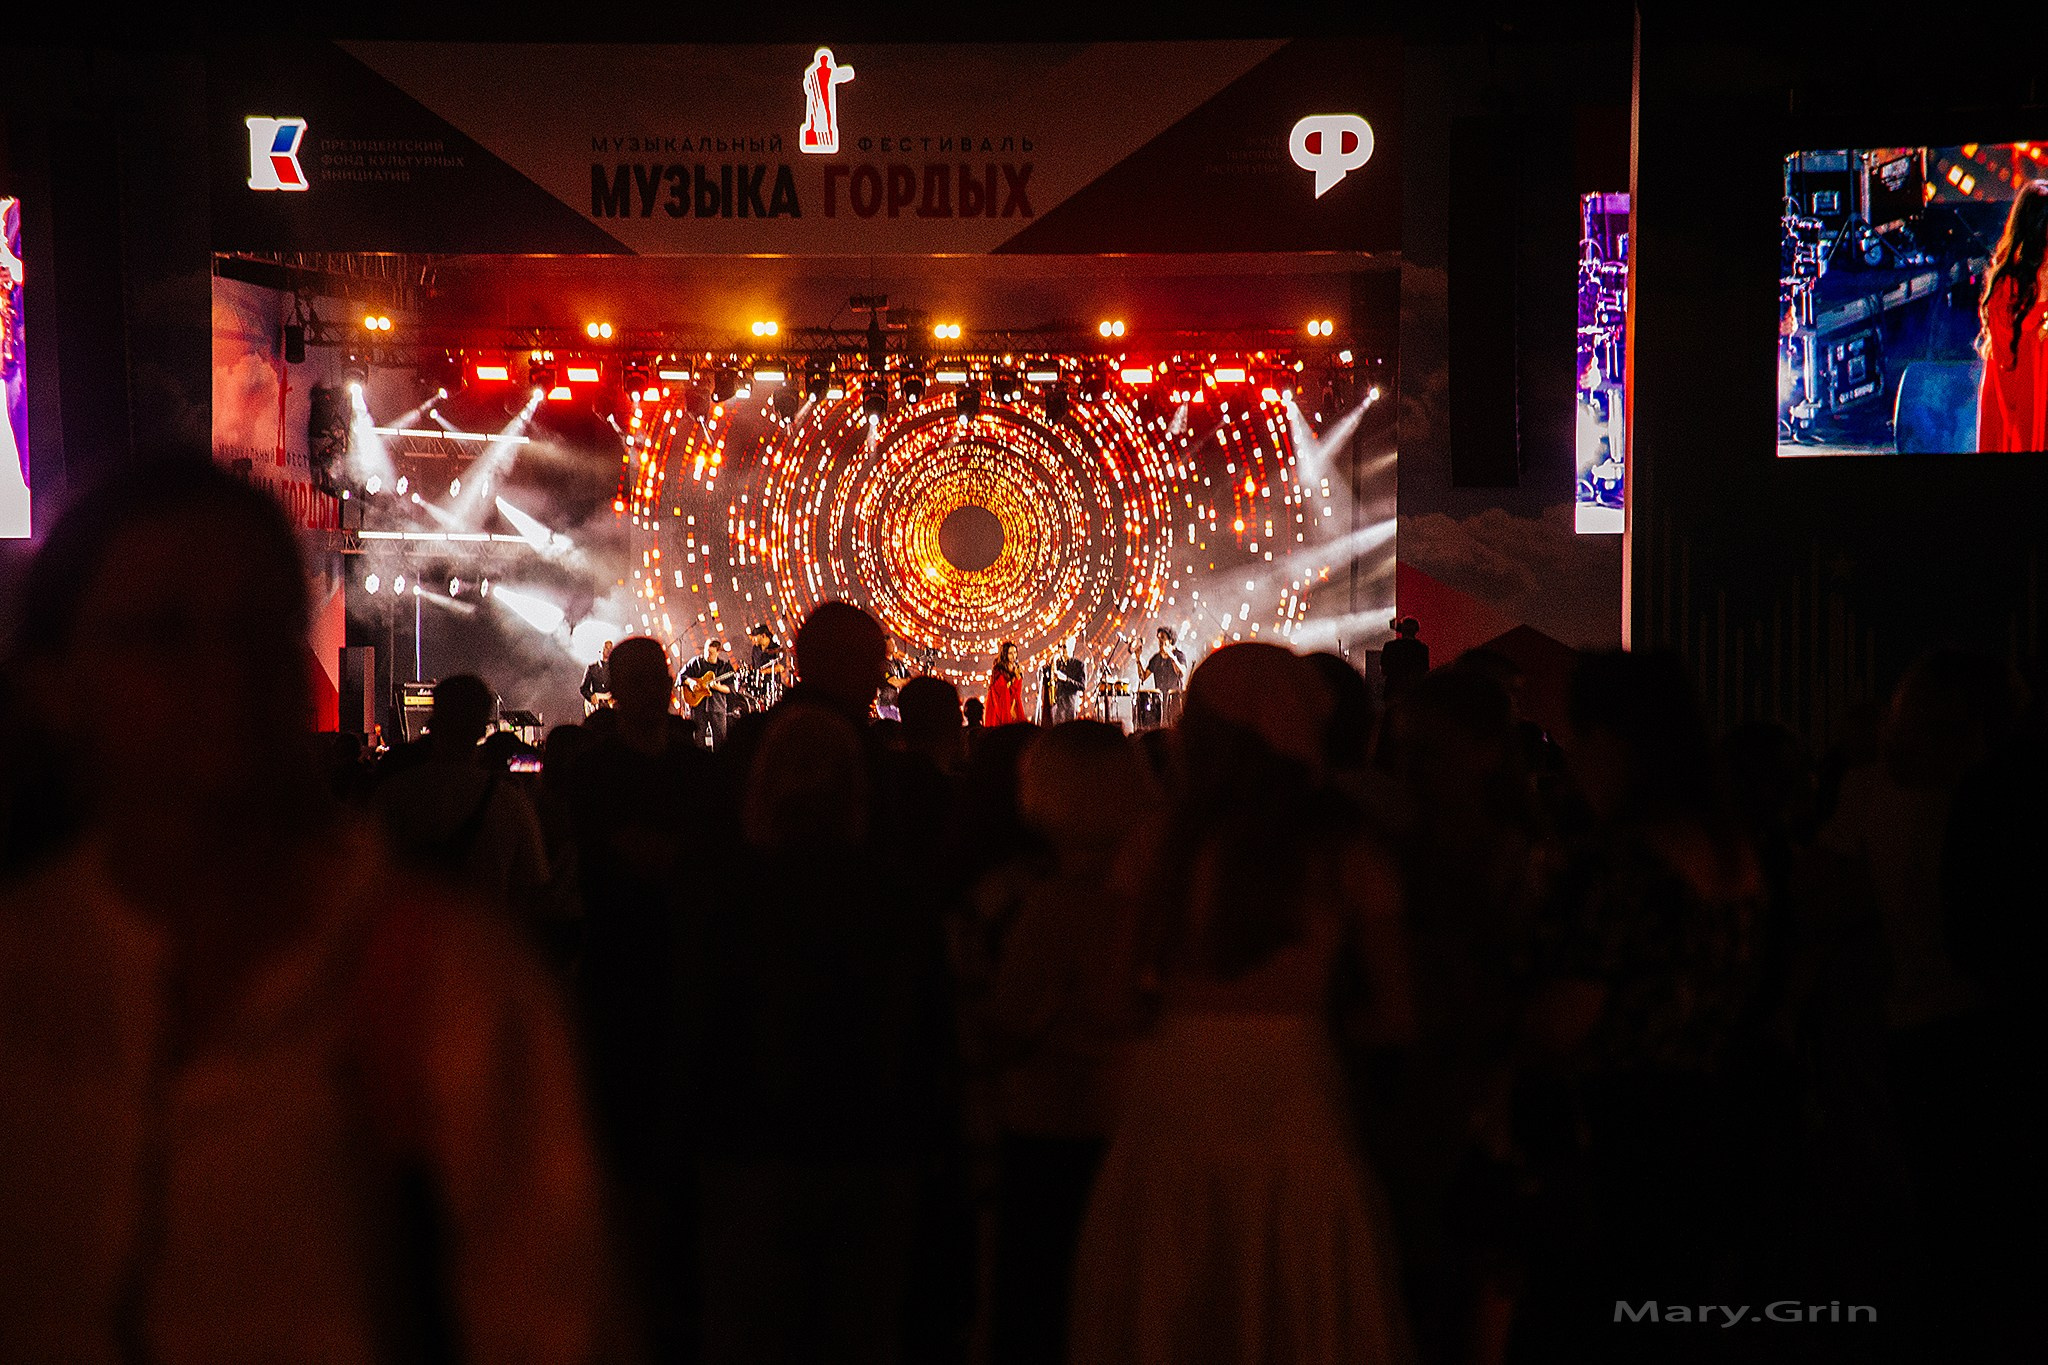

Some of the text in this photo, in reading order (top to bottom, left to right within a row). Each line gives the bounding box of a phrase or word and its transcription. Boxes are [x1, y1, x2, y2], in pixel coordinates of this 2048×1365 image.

[320, 139, 444, 152] ПРЕЗИДЕНТСКИЙ
[592, 133, 1034, 152] МУЗЫКАЛЬНЫЙ ФЕСТИВАЛЬ
[321, 154, 464, 168] ФОНД КУЛЬТУРНЫХ
[321, 170, 411, 182] ИНИЦИАТИВ
[591, 163, 1035, 218] МУЗЫКА ГОРДЫХ
